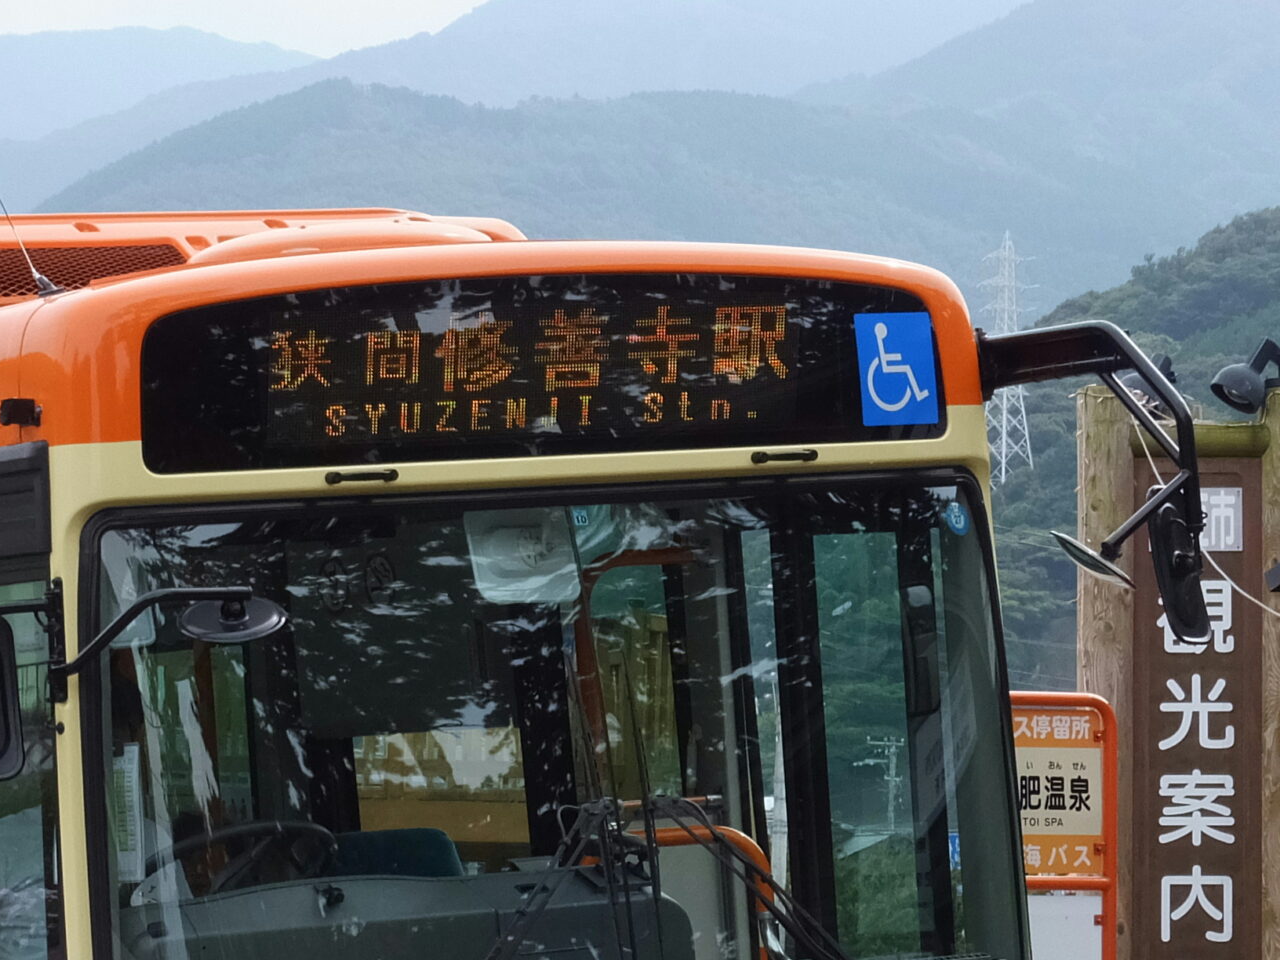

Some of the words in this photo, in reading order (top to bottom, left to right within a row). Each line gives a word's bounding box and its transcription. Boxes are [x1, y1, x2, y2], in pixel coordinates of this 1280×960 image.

[644, 392, 757, 423] Stn.
[1023, 817, 1040, 827] TOI
[1044, 817, 1064, 827] SPA
